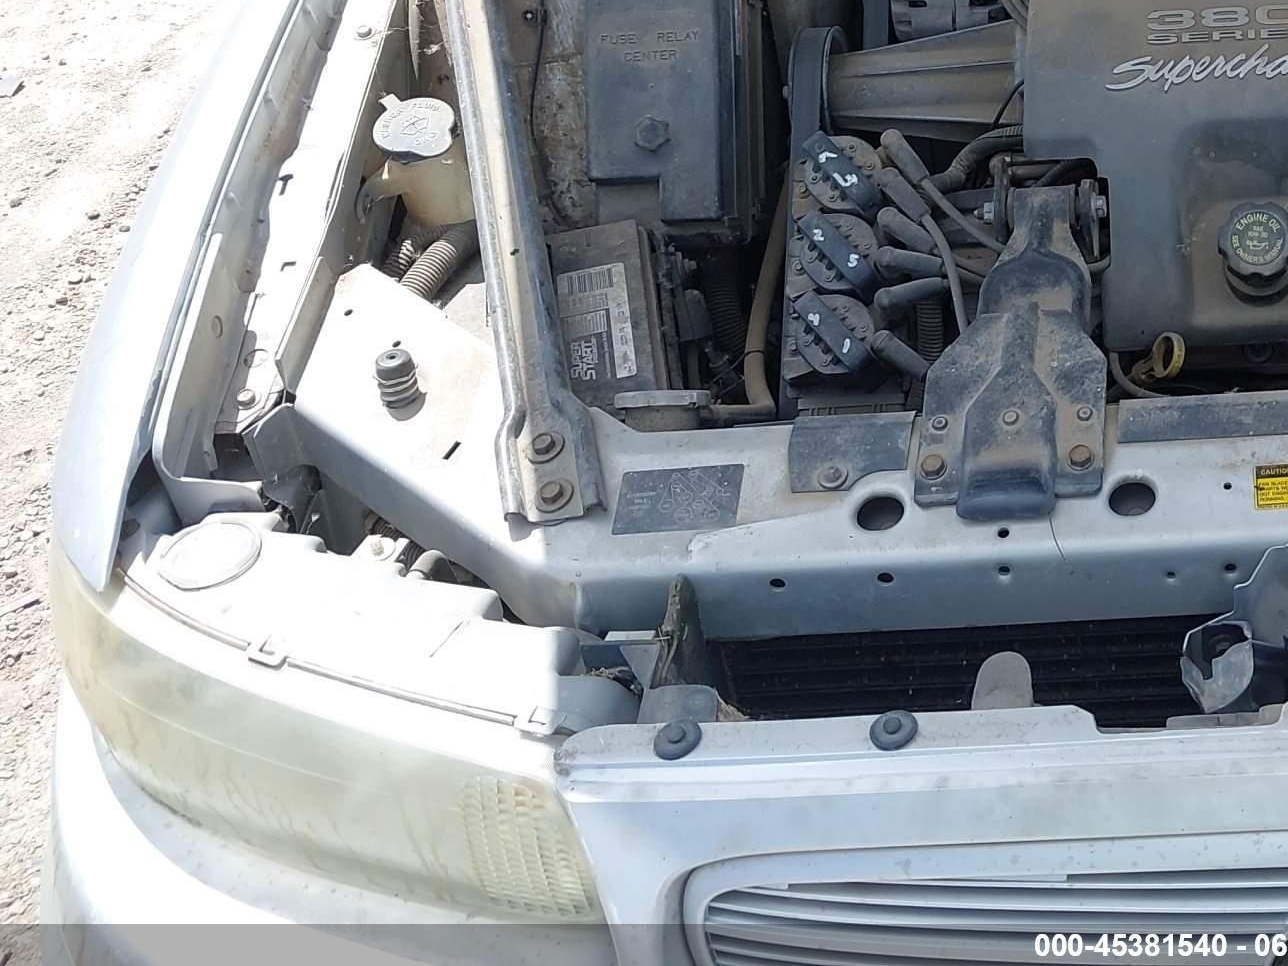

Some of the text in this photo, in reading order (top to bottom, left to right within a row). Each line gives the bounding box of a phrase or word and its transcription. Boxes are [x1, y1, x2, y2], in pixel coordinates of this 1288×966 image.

[600, 29, 700, 45] FUSE RELAY
[623, 49, 679, 63] CENTER
[1236, 212, 1281, 233] ENGINE OIL
[812, 228, 860, 268] 2 5
[1231, 234, 1240, 248] SEE
[1264, 236, 1283, 259] MANUAL
[571, 339, 583, 379] SUPER
[581, 339, 596, 381] START
